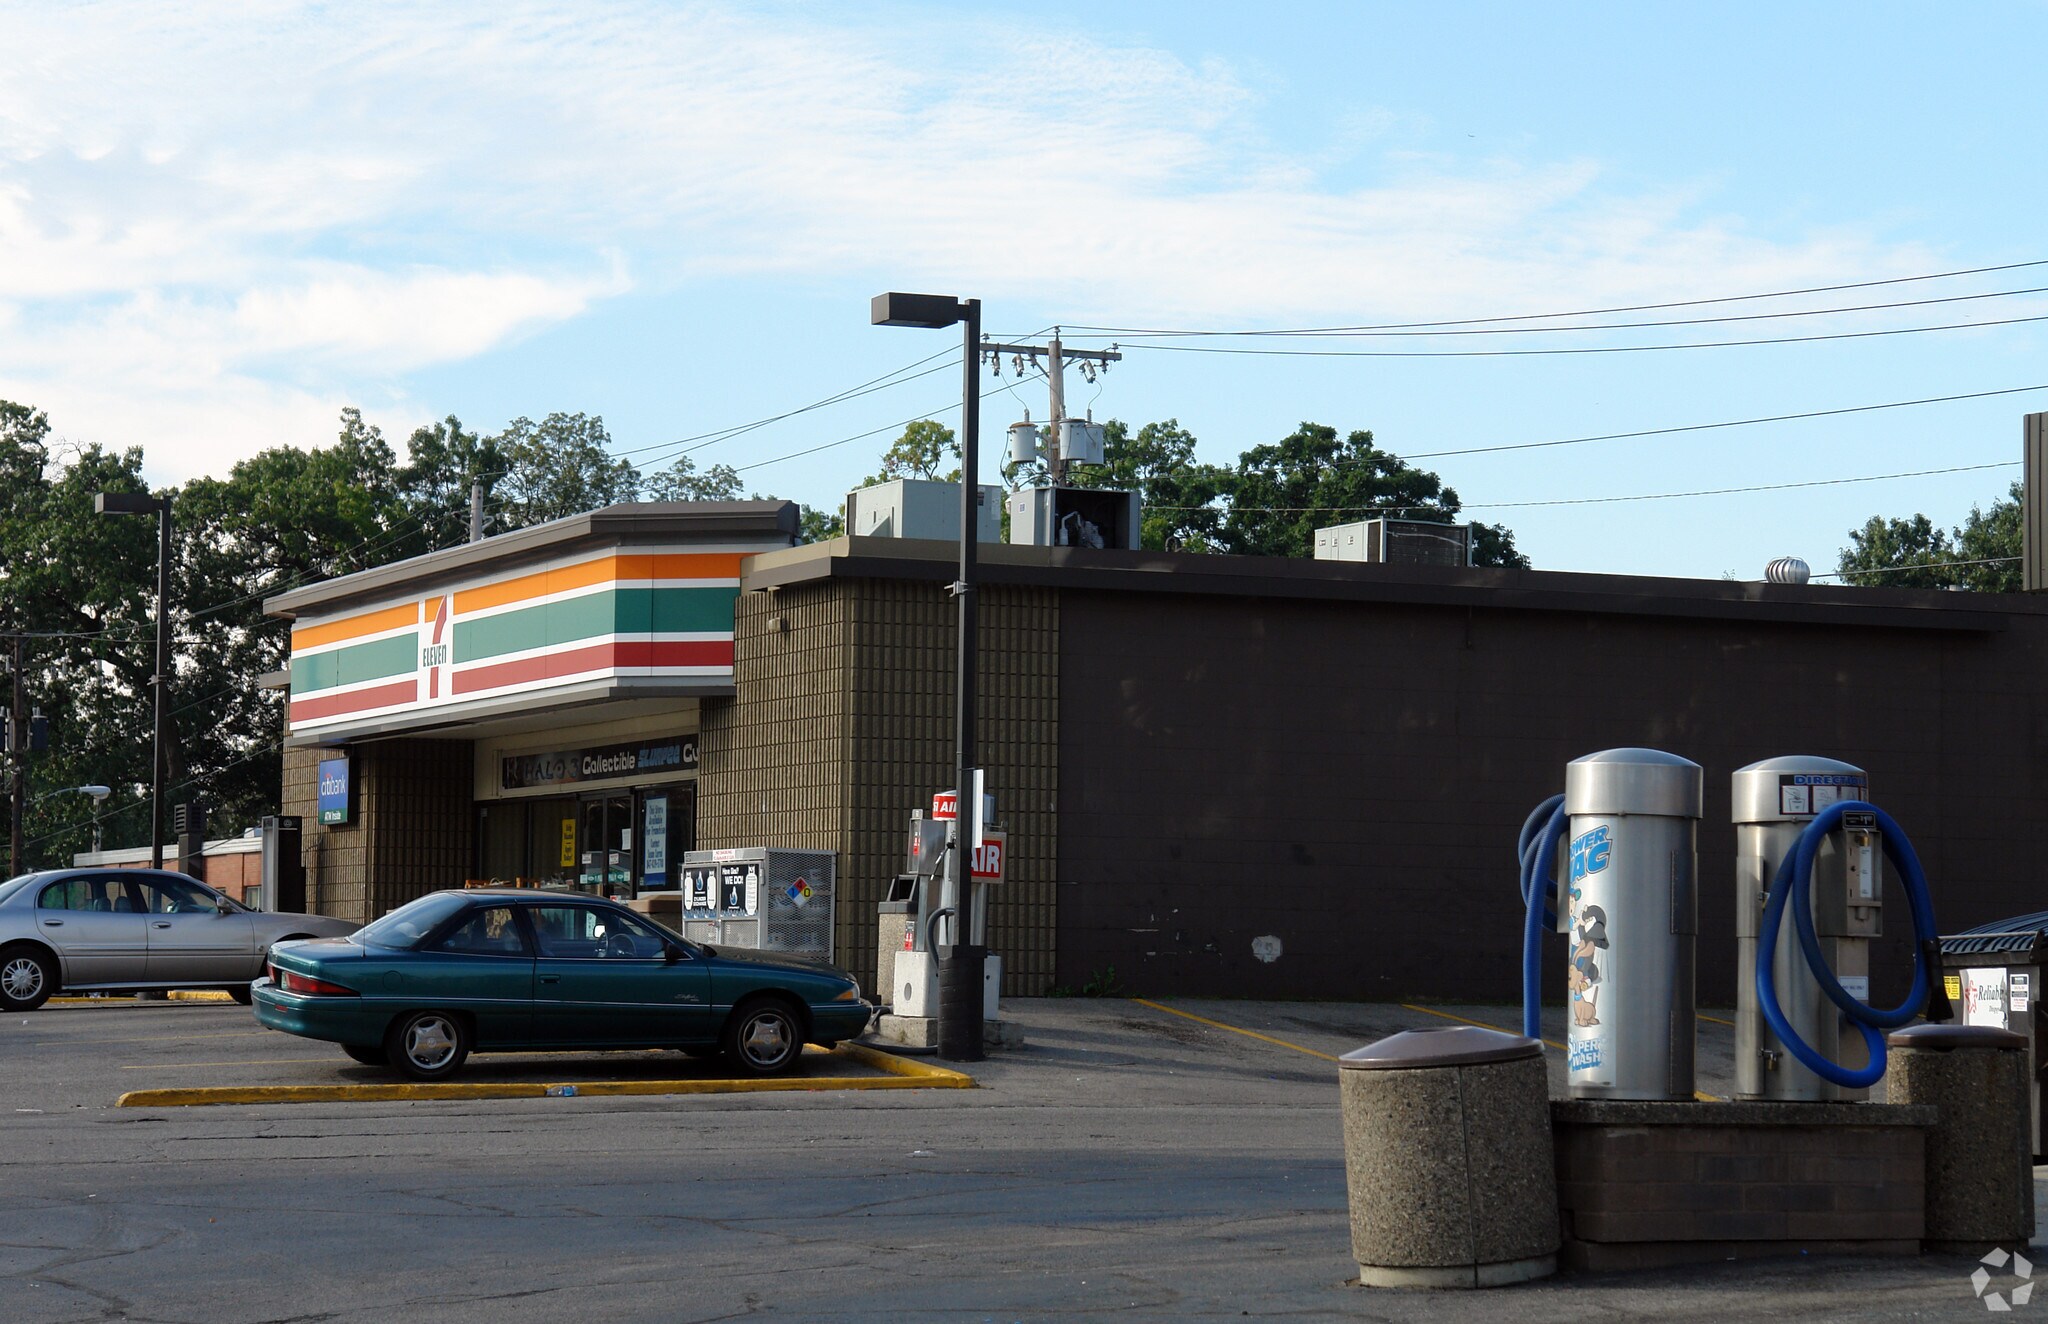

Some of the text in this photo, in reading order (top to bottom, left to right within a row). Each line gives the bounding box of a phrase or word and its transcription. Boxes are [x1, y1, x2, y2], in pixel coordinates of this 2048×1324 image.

[423, 644, 447, 667] ELEVEN
[430, 594, 447, 699] 7
[582, 752, 635, 775] Collectible
[683, 743, 699, 763] Cu
[321, 774, 346, 796] citibank
[971, 845, 1000, 874] AIR
[725, 876, 744, 885] WE DO!
[804, 888, 810, 897] 0
